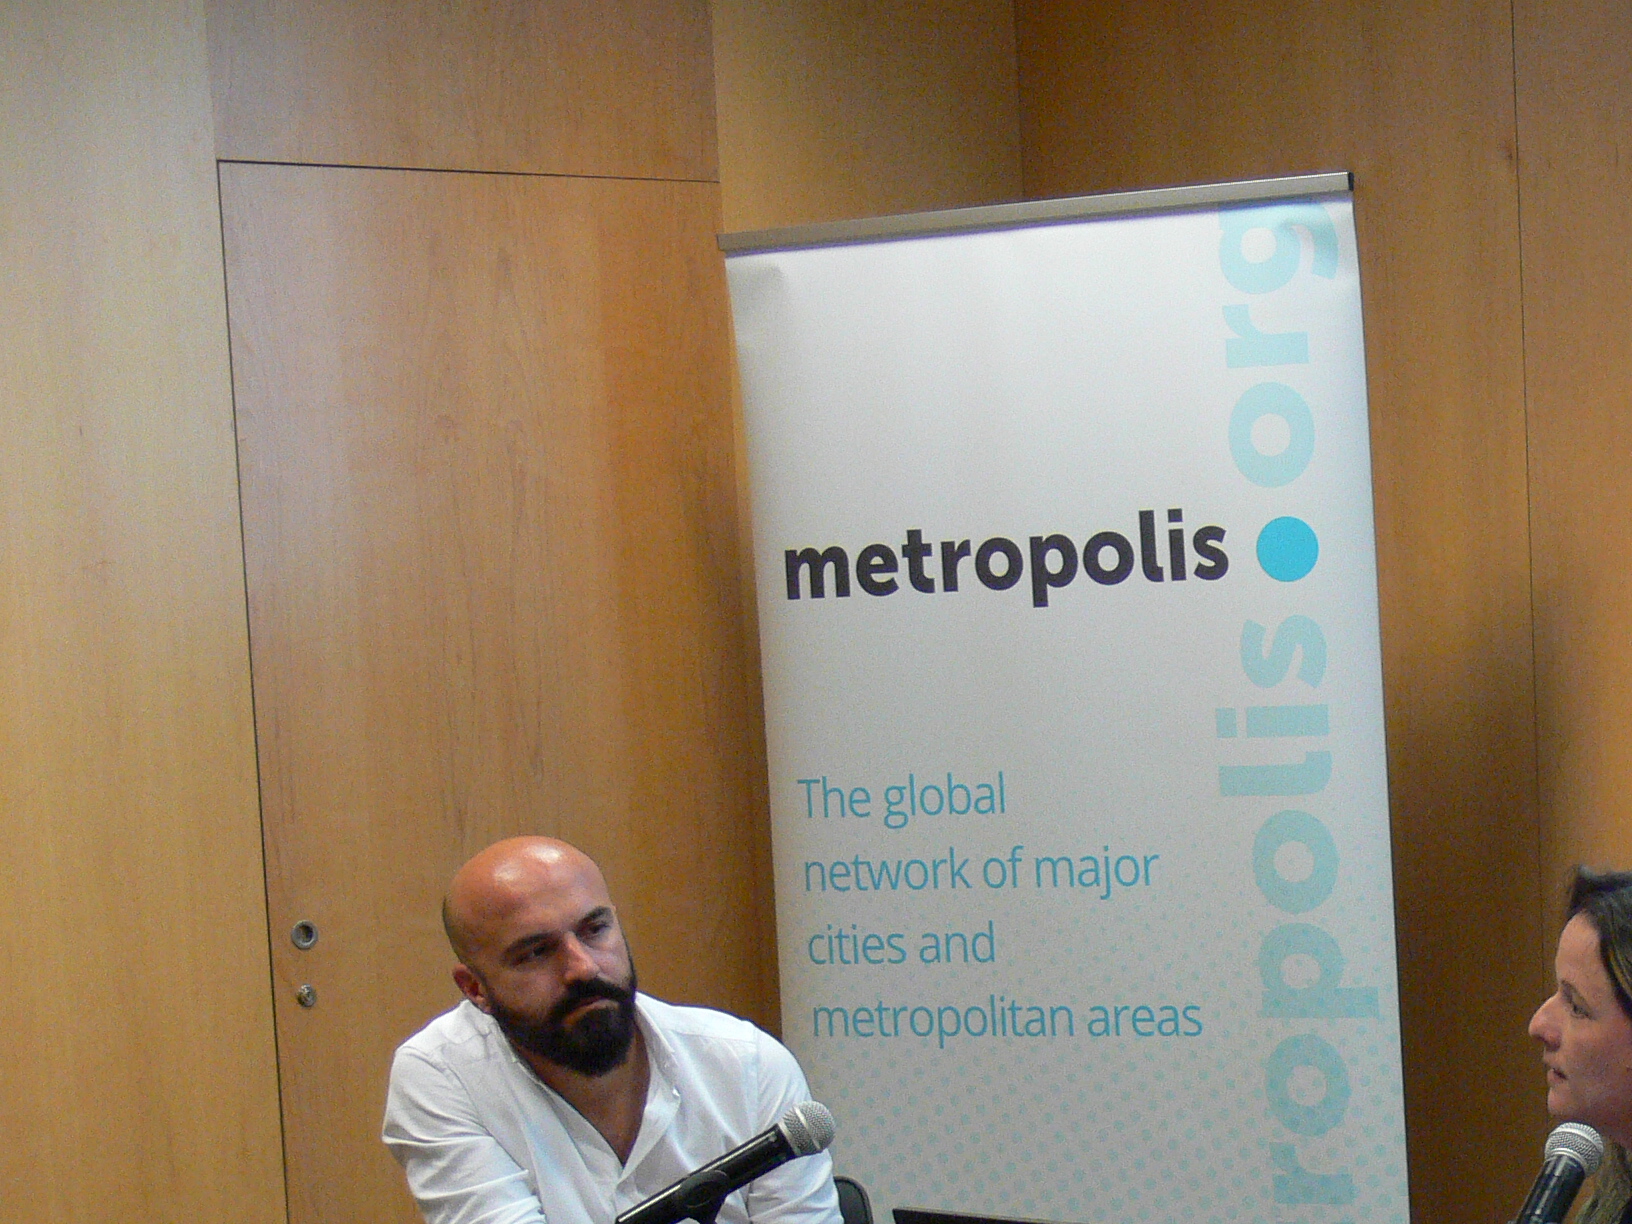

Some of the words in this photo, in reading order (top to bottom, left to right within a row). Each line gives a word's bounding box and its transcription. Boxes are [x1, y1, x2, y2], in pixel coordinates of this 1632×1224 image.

[785, 508, 1229, 607] metropolis
[797, 775, 871, 818] The
[883, 771, 1005, 829] global
[804, 847, 972, 892] network
[983, 845, 1024, 888] of
[1034, 845, 1160, 900] major
[807, 924, 907, 965] cities
[919, 920, 995, 963] and
[812, 994, 1074, 1049] metropolitan
[1087, 1004, 1202, 1037] areas
